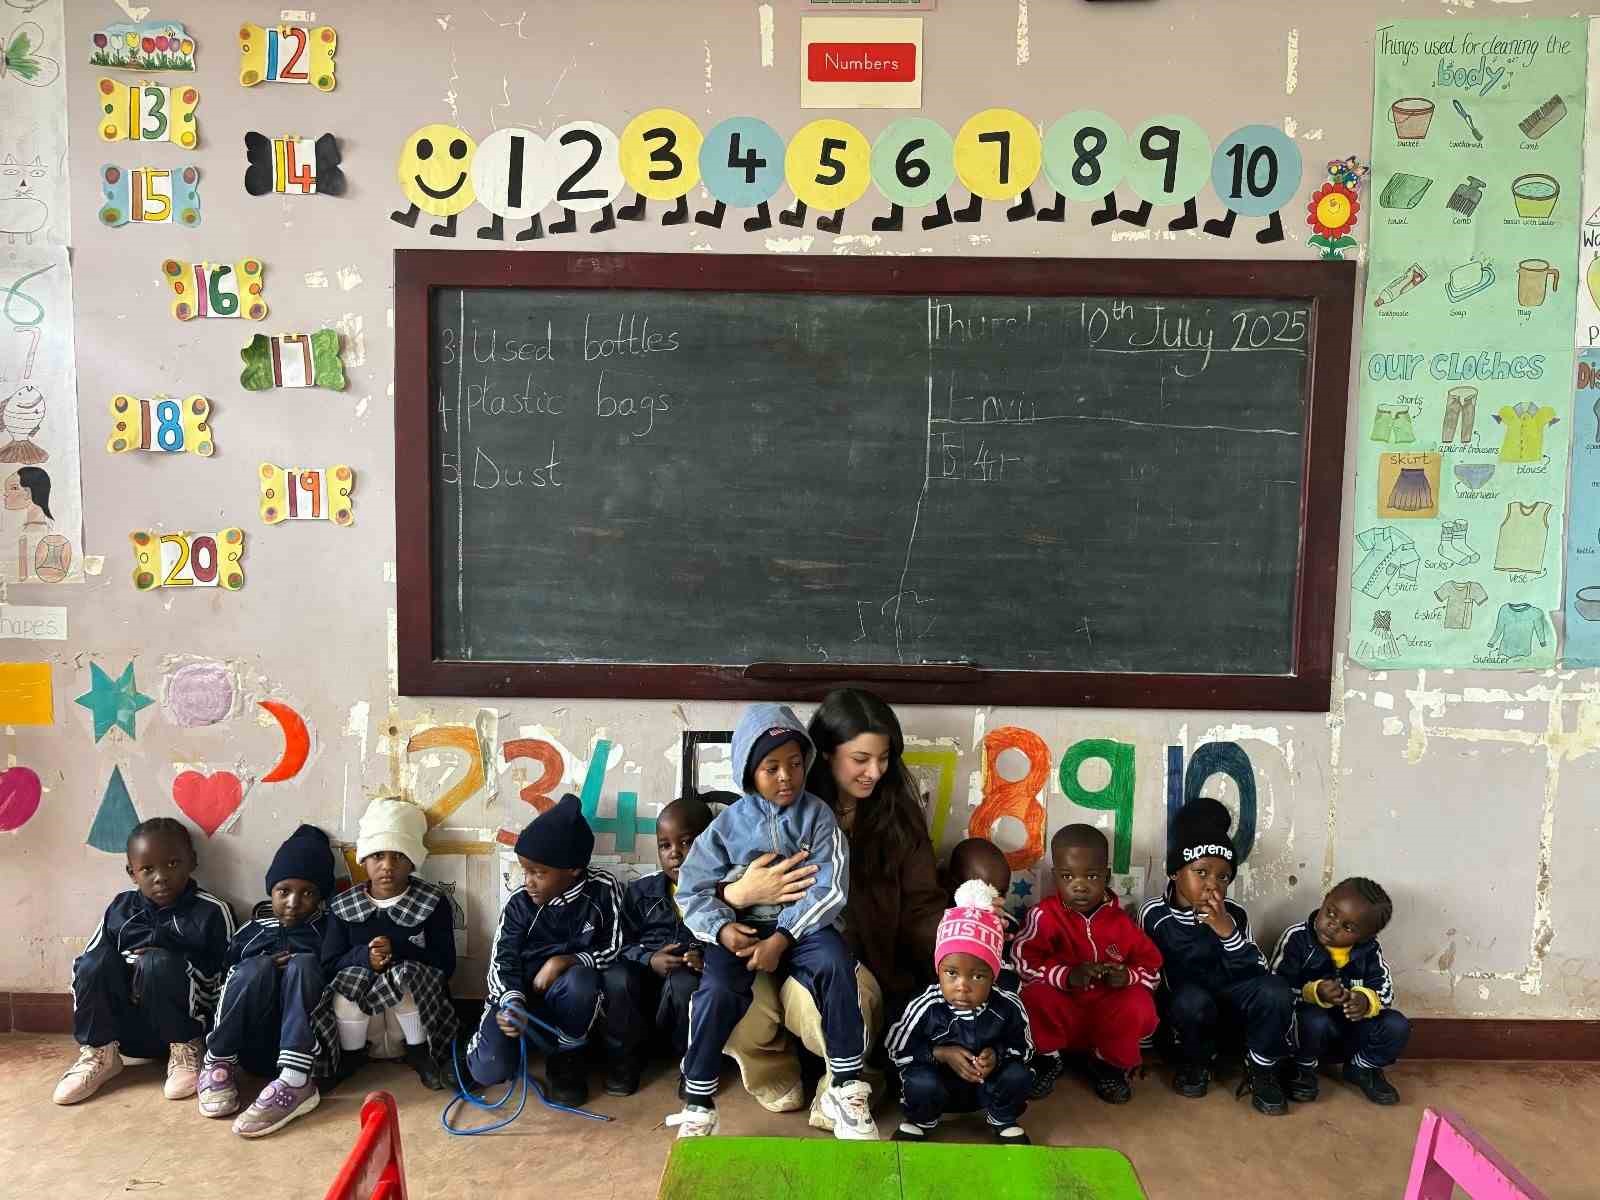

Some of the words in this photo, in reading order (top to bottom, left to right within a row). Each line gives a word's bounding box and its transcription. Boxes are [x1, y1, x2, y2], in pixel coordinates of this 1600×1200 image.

[266, 27, 309, 80] 12
[825, 52, 899, 71] Numbers
[1376, 25, 1419, 66] Things
[1424, 36, 1456, 55] used
[1461, 32, 1481, 56] for
[1481, 34, 1540, 67] cleaning
[1547, 34, 1572, 55] the
[1437, 56, 1505, 97] body
[129, 86, 168, 140] 13
[274, 139, 316, 193] 14
[507, 136, 524, 208] 1
[556, 129, 609, 201] 2
[642, 127, 683, 181] 3
[727, 132, 767, 184] 4
[814, 137, 848, 186] 5
[895, 138, 931, 188] 6
[978, 130, 1010, 184] 7
[1071, 126, 1107, 186] 8
[1139, 125, 1180, 193] 9
[1225, 143, 1279, 199] 10
[131, 170, 171, 222] 15
[194, 264, 239, 317] 16
[270, 335, 313, 387] 17
[473, 320, 556, 363] Used
[585, 312, 680, 361] bottles
[1128, 303, 1214, 378] July
[1231, 309, 1307, 352] 2025
[140, 400, 184, 451] 18
[597, 370, 670, 436] bags
[473, 440, 562, 488] Dust
[1517, 466, 1548, 475] blouse
[288, 472, 321, 518] 19
[160, 535, 218, 586] 20
[577, 740, 656, 852] 4
[969, 726, 1052, 871] 8
[1059, 739, 1136, 874] 9
[1183, 844, 1233, 861] Supreme
